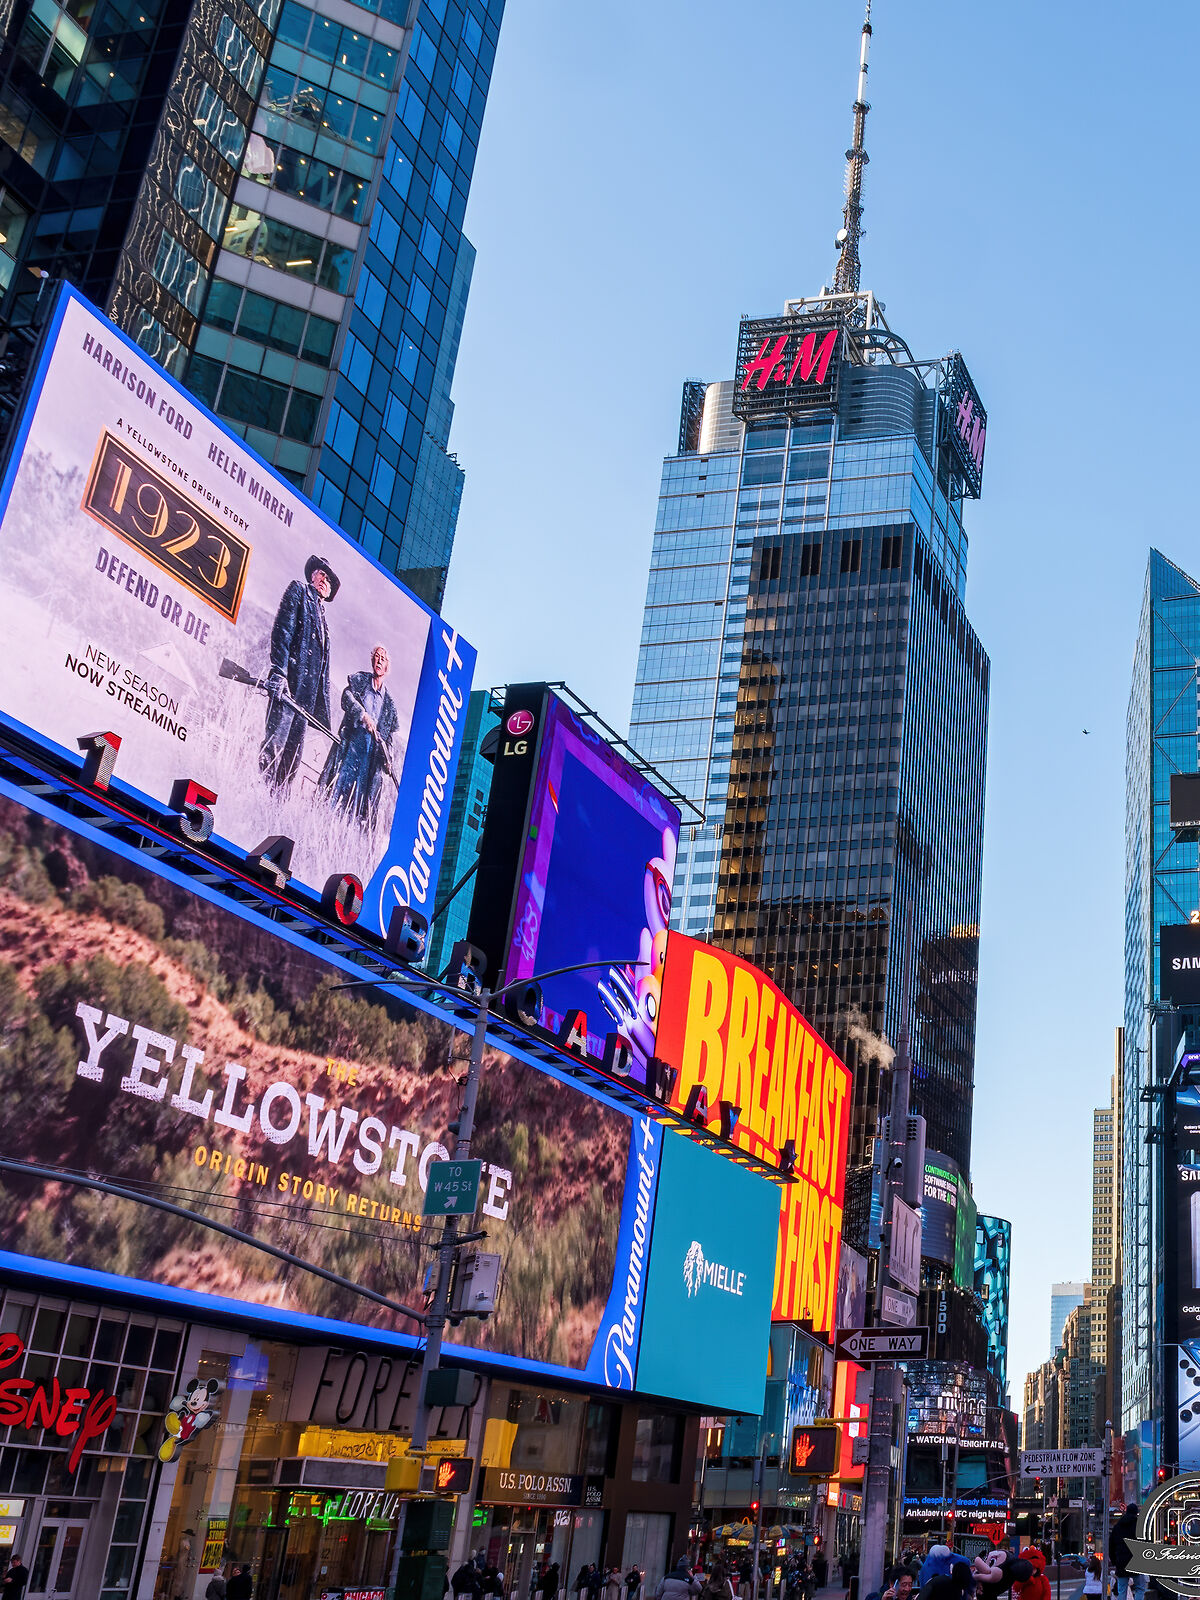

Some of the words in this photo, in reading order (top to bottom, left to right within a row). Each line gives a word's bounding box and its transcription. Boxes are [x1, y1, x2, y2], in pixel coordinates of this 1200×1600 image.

[742, 330, 838, 391] H&M
[82, 332, 157, 410] HARRISON
[158, 399, 193, 440] FORD
[116, 417, 124, 428] A
[126, 422, 190, 482] YELLOWSTONE
[191, 480, 221, 508] ORIGIN
[223, 504, 249, 531] STORY
[208, 441, 247, 488] HELEN
[249, 480, 293, 527] MIRREN
[109, 458, 230, 589] 1923
[95, 547, 159, 609] DEFEND
[160, 594, 182, 627] OR
[183, 611, 210, 645] DIE
[65, 654, 104, 688] NOW
[106, 681, 188, 742] STREAMING
[85, 645, 120, 676] NEW
[122, 670, 179, 715] SEASON
[503, 740, 528, 756] LG
[326, 1057, 359, 1087] THE
[678, 950, 847, 1198] BREAKFAST
[195, 1145, 269, 1186] ORIGIN
[278, 1172, 340, 1207] STORY
[347, 1193, 423, 1233] RETURNS
[434, 1182, 442, 1192] W
[444, 1181, 458, 1192] 45
[461, 1180, 472, 1191] St
[449, 1166, 462, 1177] TO
[924, 1184, 937, 1198] FOR
[703, 1260, 745, 1296] MIELLE
[938, 1290, 947, 1334] 1500
[850, 1338, 875, 1351] ONE
[888, 1337, 916, 1350] WAY
[916, 1436, 944, 1444] WATCH
[1024, 1453, 1060, 1463] PEDESTRIAN
[1063, 1453, 1078, 1461] FLOW
[1080, 1452, 1096, 1461] ZONE
[500, 1472, 516, 1489] U.S.
[518, 1473, 545, 1491] POLO
[546, 1476, 573, 1493] ASSN.
[1056, 1464, 1071, 1473] KEEP
[1072, 1463, 1096, 1473] MOVING
[954, 1510, 967, 1518] UFC
[968, 1510, 987, 1519] reign
